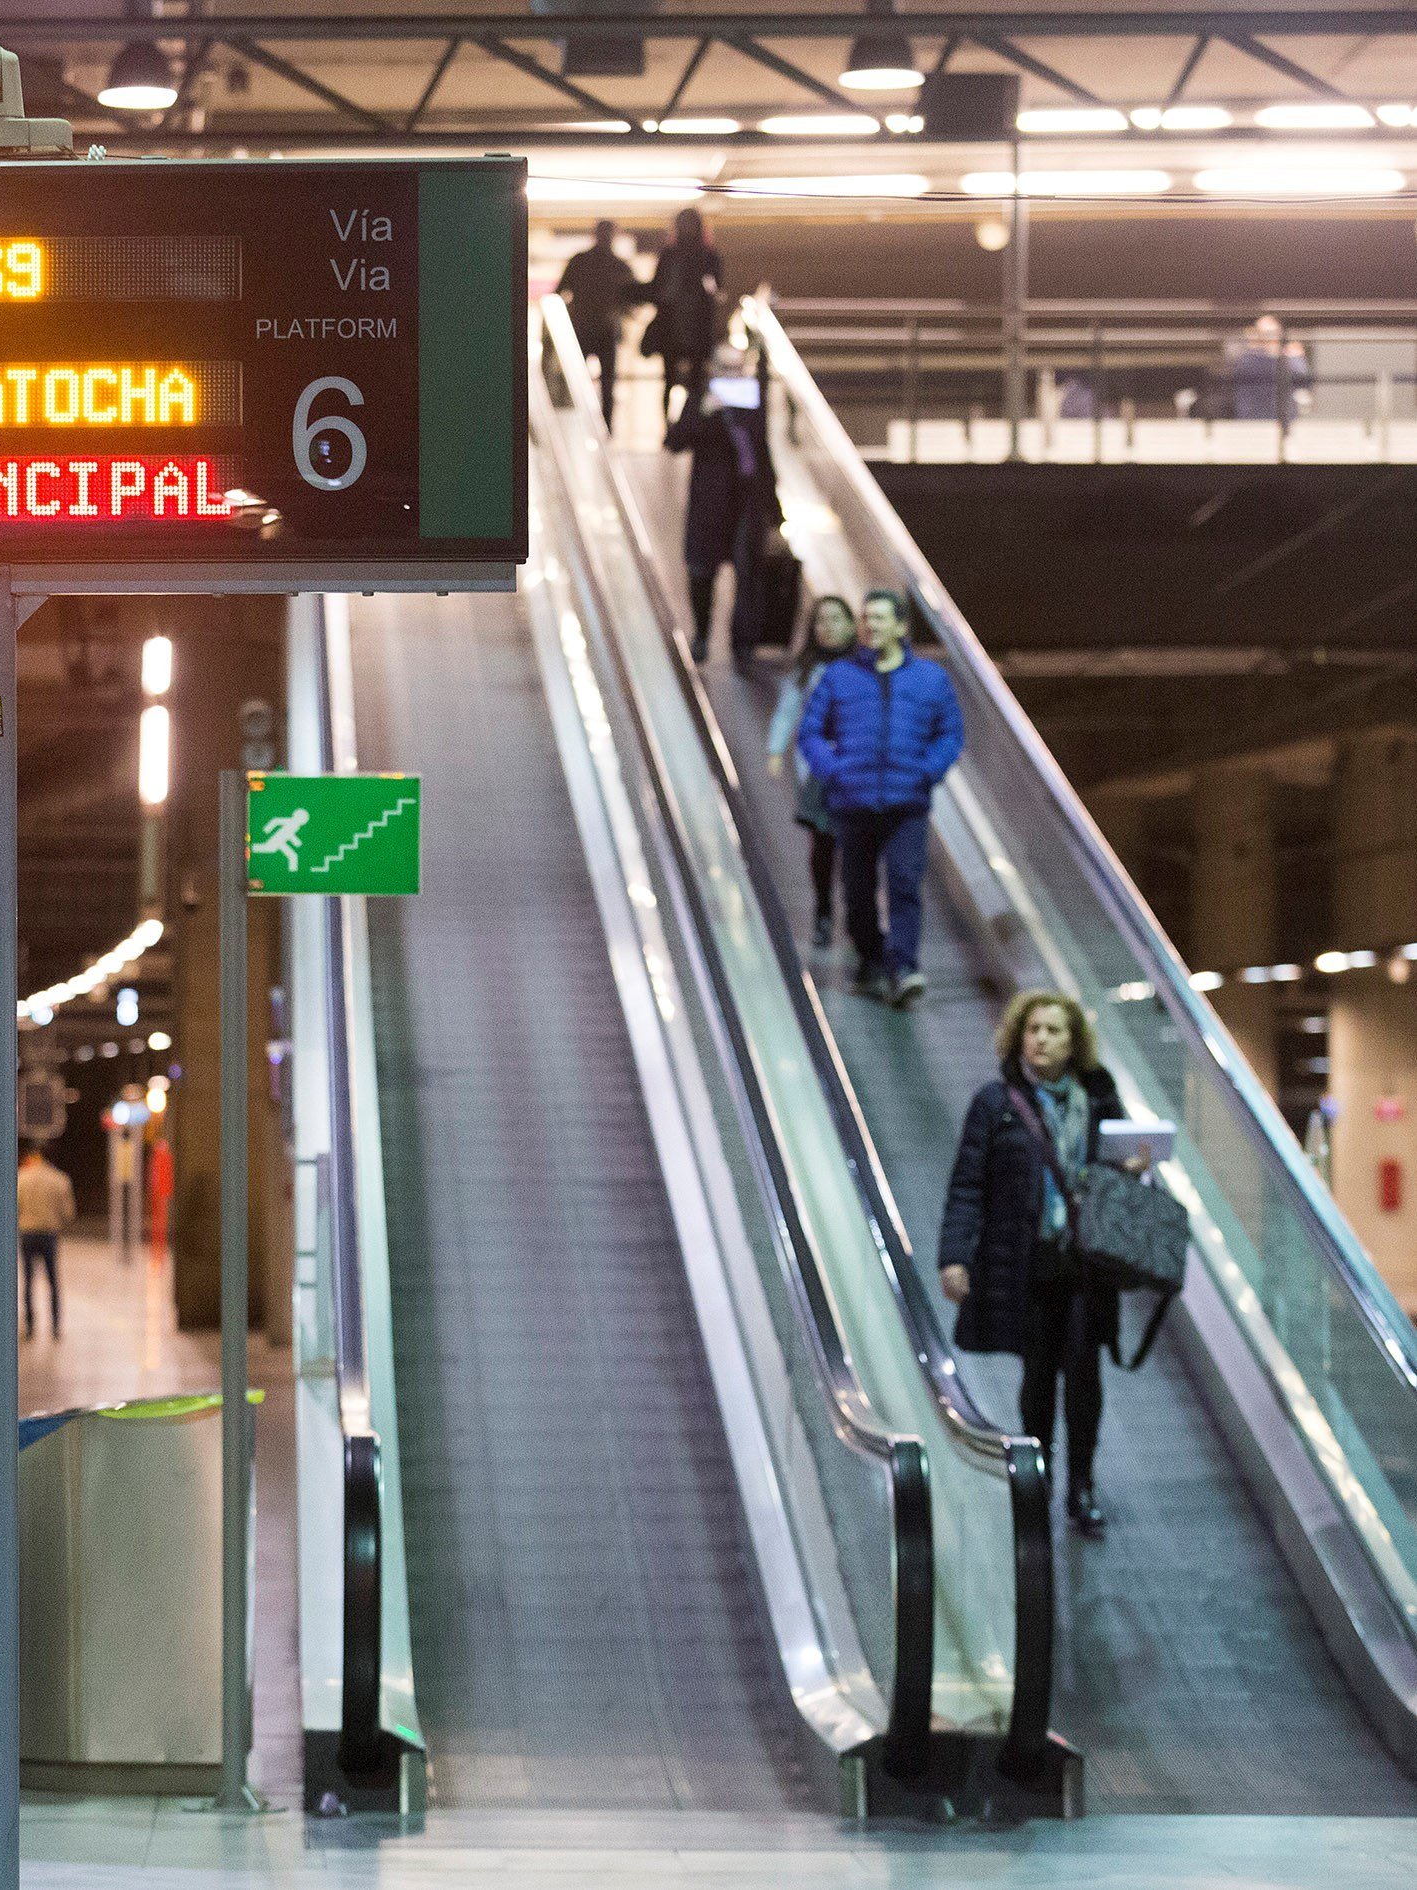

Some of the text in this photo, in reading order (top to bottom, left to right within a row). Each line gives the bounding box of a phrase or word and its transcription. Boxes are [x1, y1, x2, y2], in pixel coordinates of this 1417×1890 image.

[329, 208, 394, 242] Vía
[329, 258, 391, 292] Via
[255, 317, 398, 340] PLATFORM
[291, 375, 368, 492] 6
